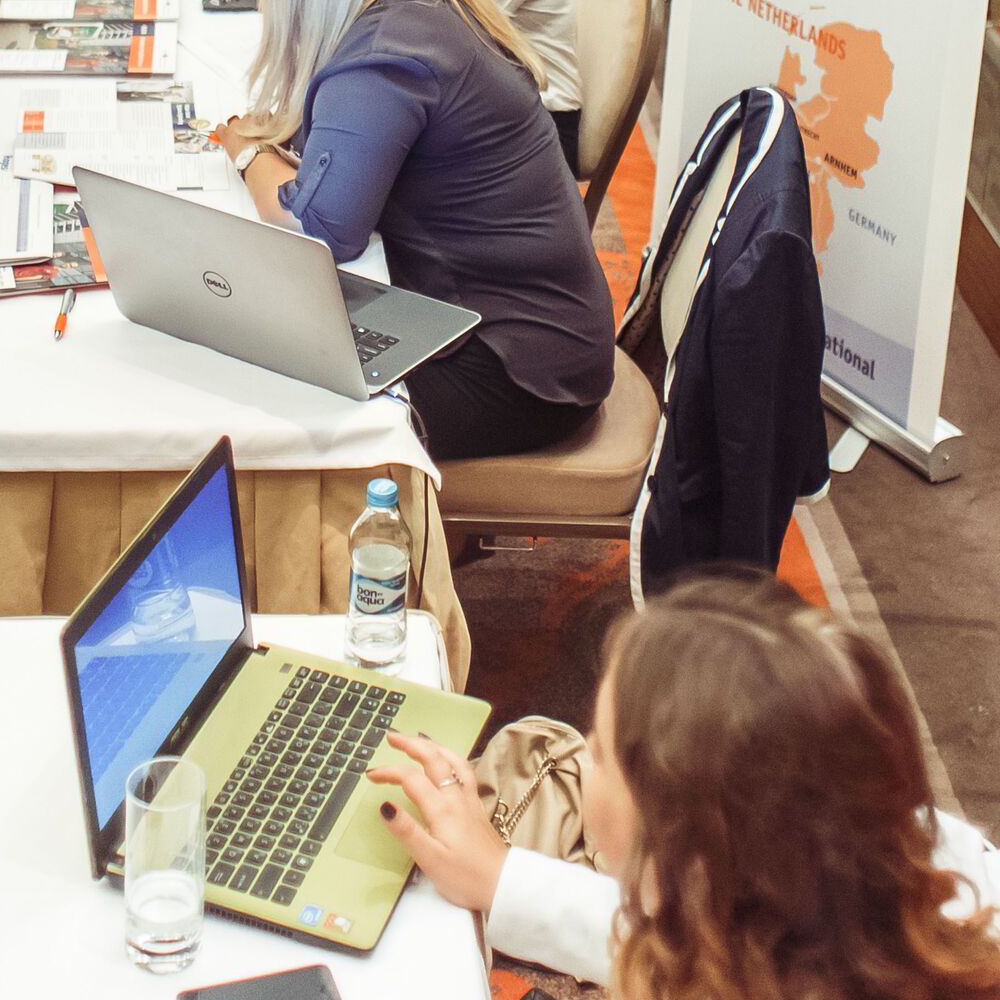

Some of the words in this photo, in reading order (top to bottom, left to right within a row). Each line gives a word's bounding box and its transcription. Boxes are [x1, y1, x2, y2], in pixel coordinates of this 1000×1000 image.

[824, 153, 858, 180] ARNHEM
[848, 208, 897, 247] GERMANY
[206, 278, 229, 291] DELL
[825, 335, 875, 380] ational
[357, 584, 377, 598] bon
[357, 595, 384, 606] aqua
